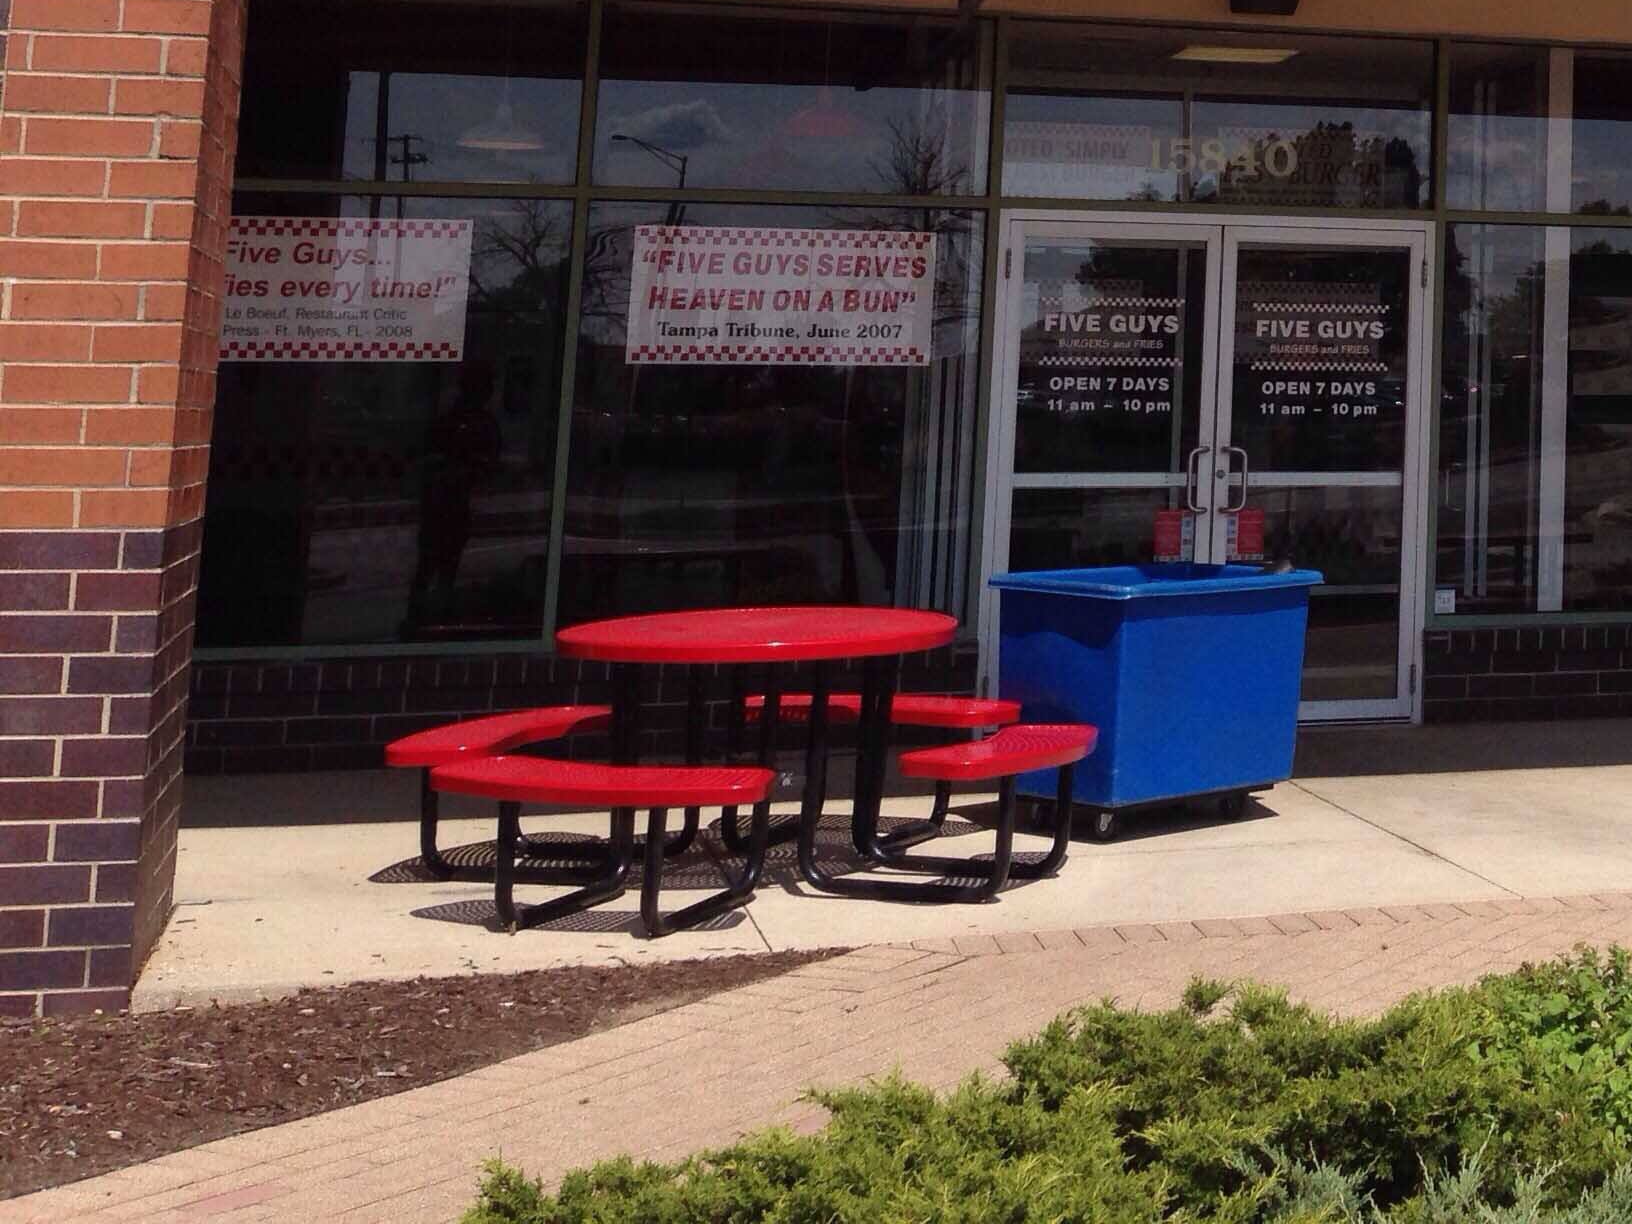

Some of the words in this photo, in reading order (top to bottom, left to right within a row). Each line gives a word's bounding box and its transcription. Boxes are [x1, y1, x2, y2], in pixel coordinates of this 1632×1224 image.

[1151, 136, 1299, 177] 15840
[733, 251, 809, 277] GUYS
[817, 253, 927, 278] SERVES
[224, 274, 269, 298] ies
[280, 279, 361, 303] every
[648, 286, 765, 311] HEAVEN
[773, 289, 810, 312] ON
[817, 289, 834, 313] A
[295, 307, 368, 322] Restaurant
[372, 307, 408, 322] Critic
[657, 321, 718, 340] Tampa
[726, 322, 800, 340] Tribune,
[807, 323, 851, 339] June
[856, 324, 903, 339] 2007
[1044, 313, 1101, 333] FIVE
[1109, 314, 1180, 334] GUYS
[1256, 319, 1310, 338] FIVE
[1317, 320, 1385, 339] GUYS
[375, 325, 413, 338] 2008
[1059, 338, 1110, 349] BURGERS
[1133, 339, 1164, 350] FRIES
[1270, 344, 1319, 354] BURGERS
[1341, 344, 1370, 354] FRIES
[1050, 377, 1101, 391] OPEN
[1106, 377, 1117, 391] 7
[1122, 377, 1170, 391] DAYS
[1261, 381, 1311, 395] OPEN
[1315, 382, 1326, 395] 7
[1330, 382, 1376, 395] DAYS
[1048, 399, 1063, 411] 11
[1070, 400, 1095, 411] am
[1123, 399, 1141, 411] 10
[1145, 400, 1171, 413] pm
[1260, 403, 1275, 415] 11
[1281, 404, 1305, 415] am
[1331, 403, 1349, 415] 10
[1353, 404, 1378, 417] pm
